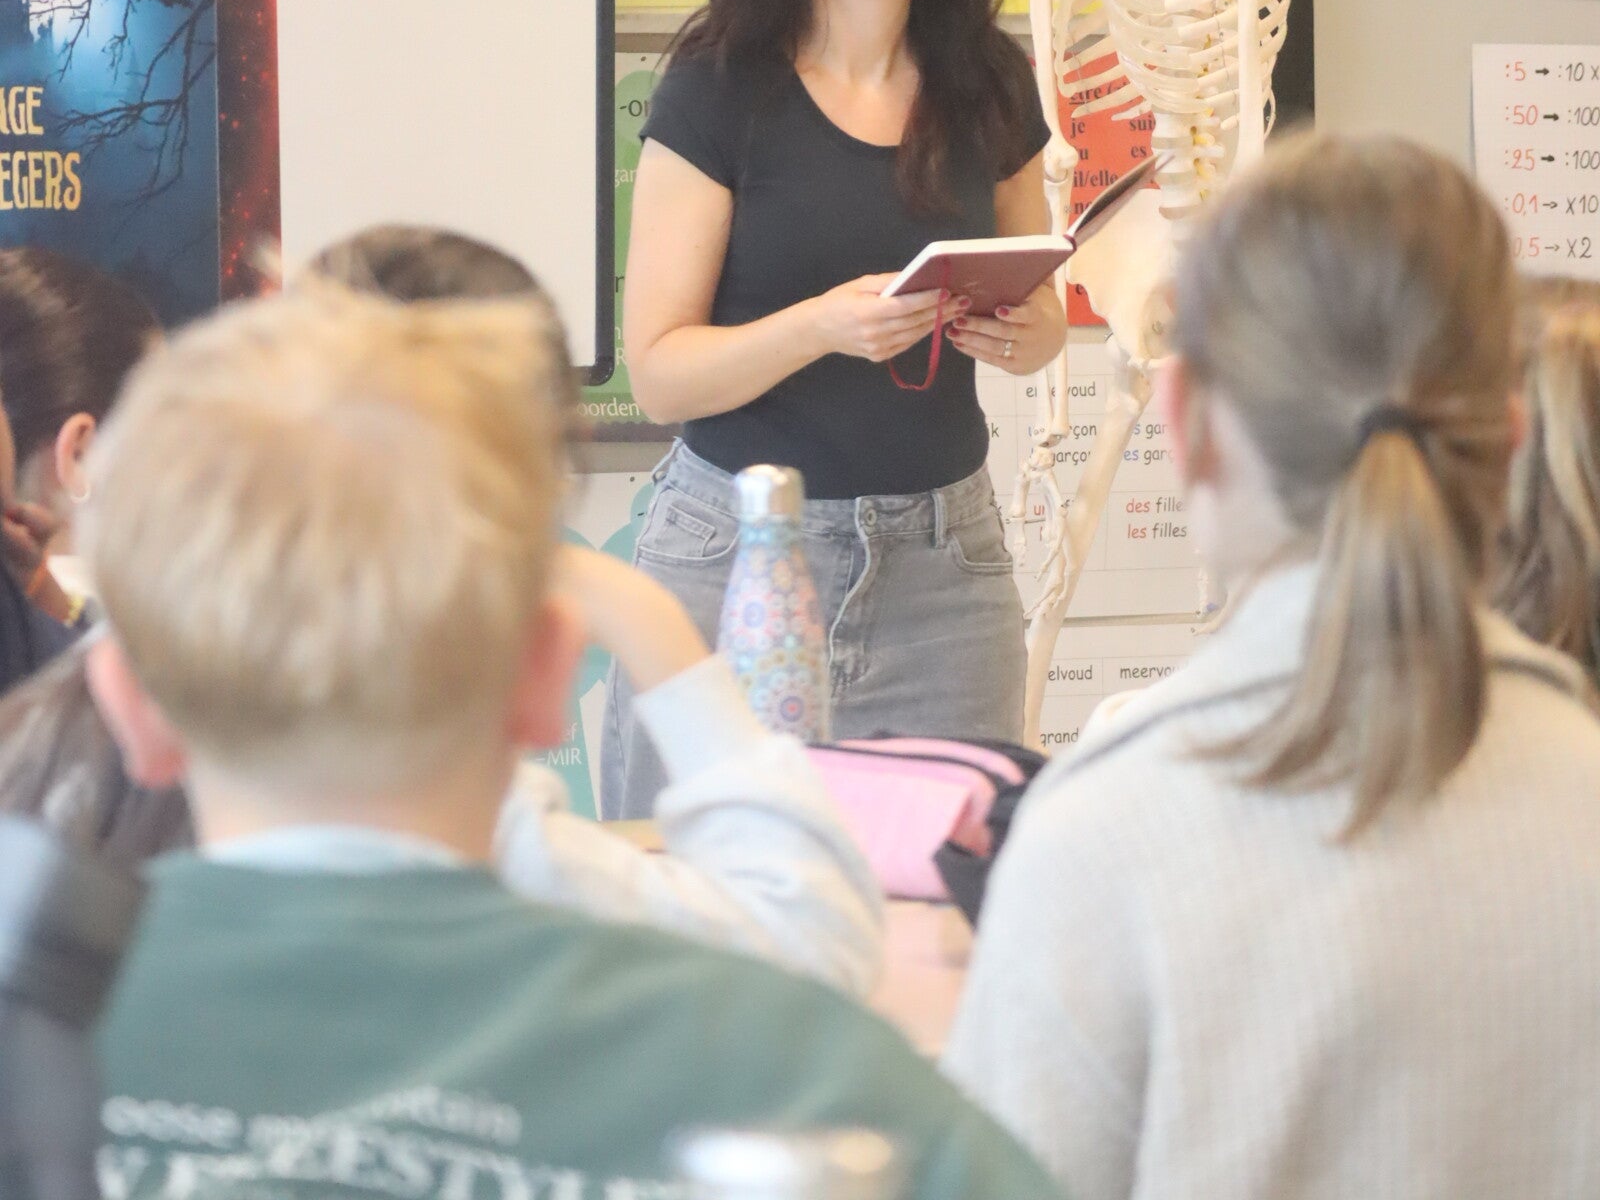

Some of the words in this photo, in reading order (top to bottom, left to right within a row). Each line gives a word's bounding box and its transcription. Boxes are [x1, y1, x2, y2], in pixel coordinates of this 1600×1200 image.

[1070, 117, 1086, 138] je
[1130, 145, 1147, 158] es
[1126, 497, 1150, 513] des
[1156, 497, 1186, 514] fille
[1127, 523, 1147, 539] les
[1153, 522, 1187, 539] filles
